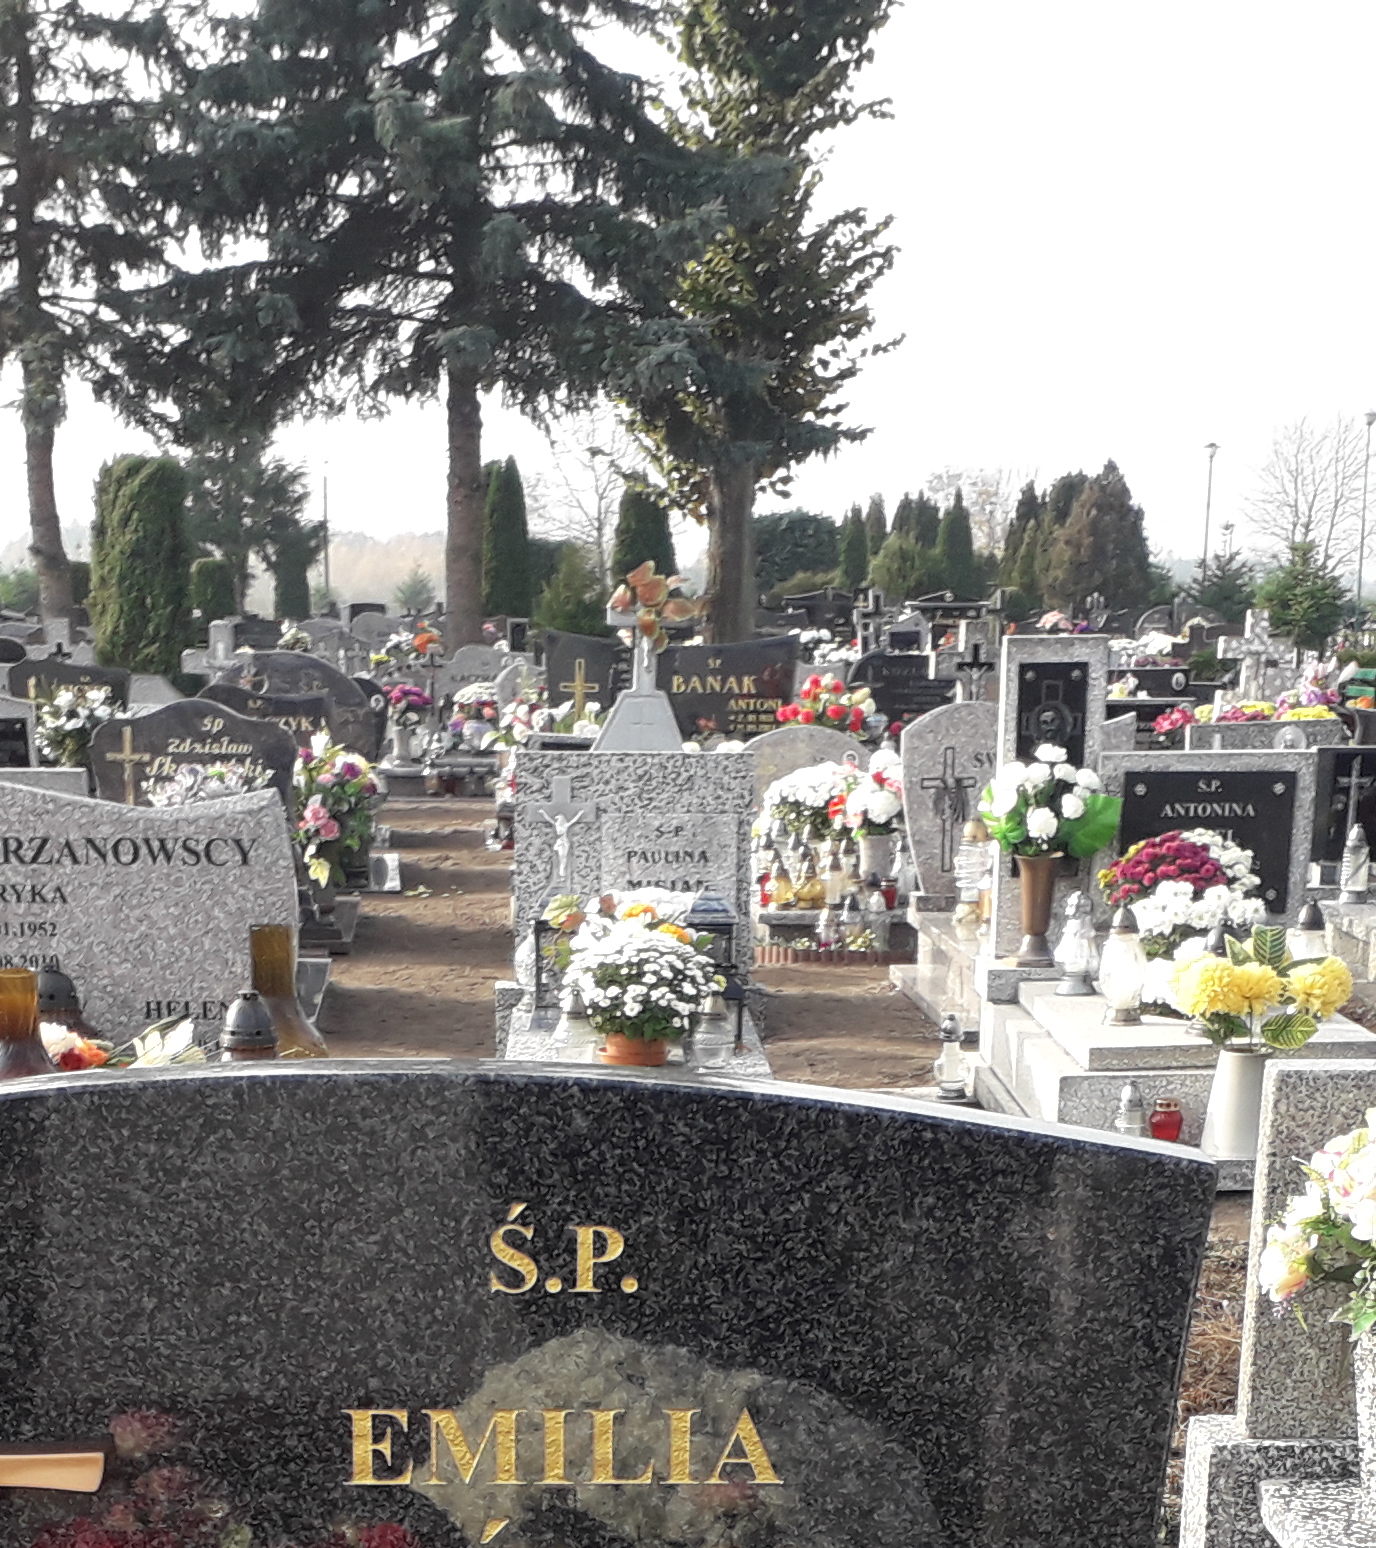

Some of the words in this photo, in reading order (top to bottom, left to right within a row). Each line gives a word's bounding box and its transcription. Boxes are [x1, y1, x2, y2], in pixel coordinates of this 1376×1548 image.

[671, 675, 758, 694] BANAK
[1160, 802, 1256, 818] ANTONINA
[627, 850, 710, 864] PAULINA
[488, 1202, 640, 1296] Ś.P.
[341, 1408, 786, 1487] EMILIA
